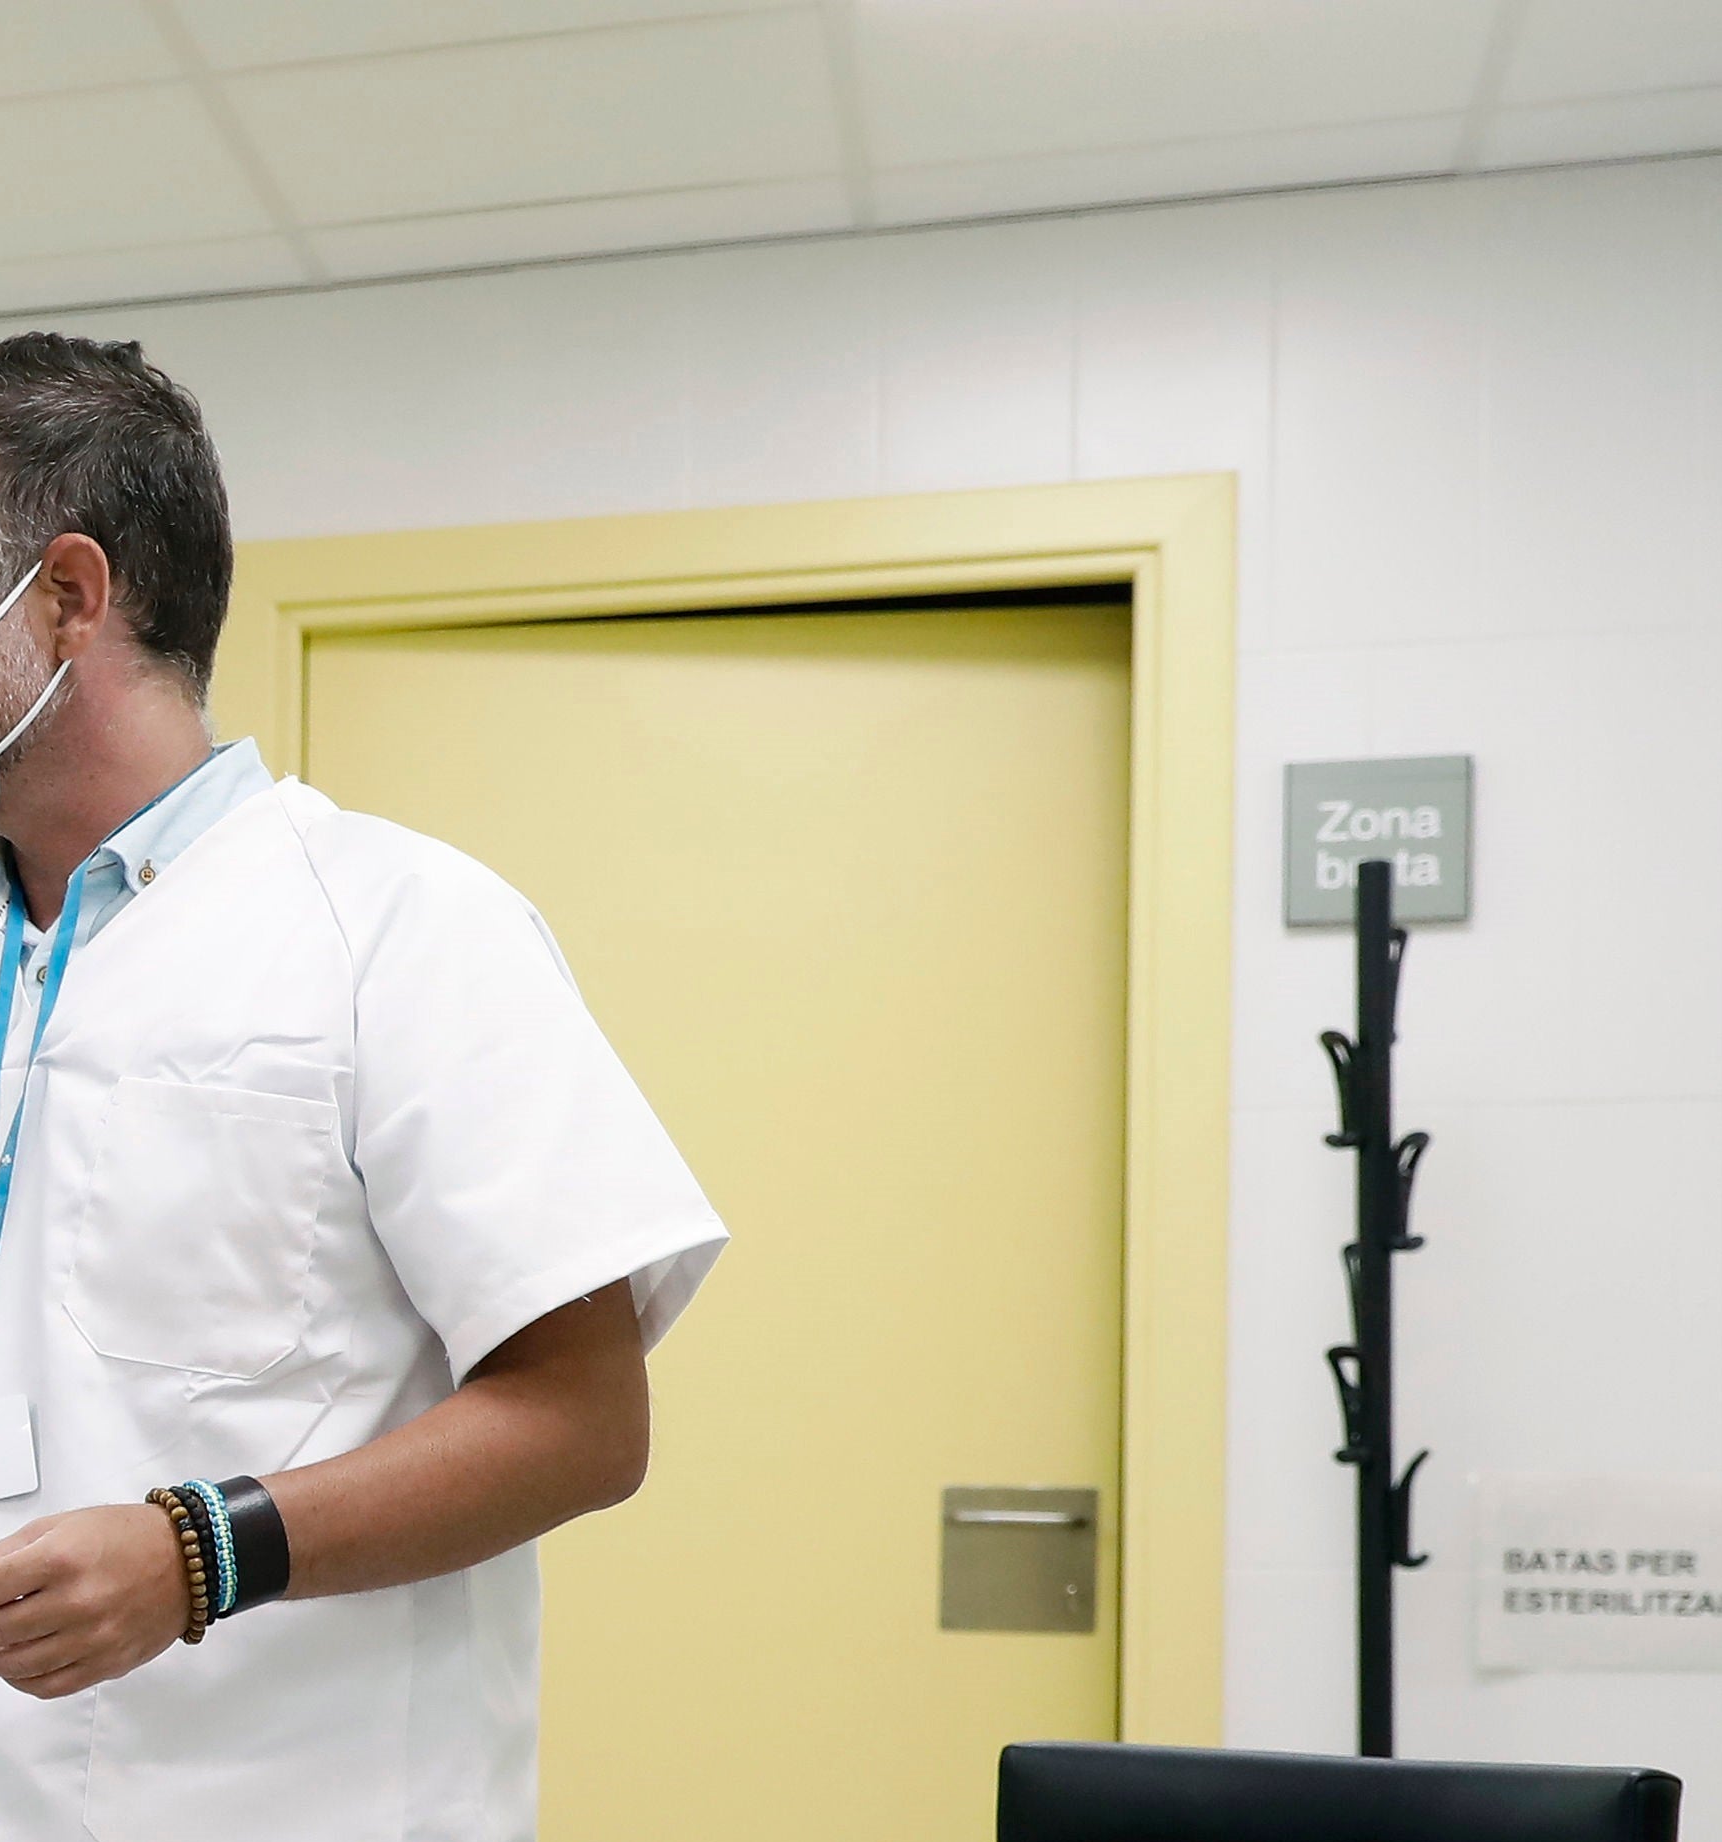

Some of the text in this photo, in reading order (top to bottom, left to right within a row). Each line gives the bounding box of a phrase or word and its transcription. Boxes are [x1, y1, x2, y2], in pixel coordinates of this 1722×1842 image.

[1316, 800, 1442, 843] Zona
[1316, 848, 1441, 890] brta
[1504, 1548, 1697, 1576] BATAS PER
[1504, 1588, 1722, 1616] ESTERILITZA
